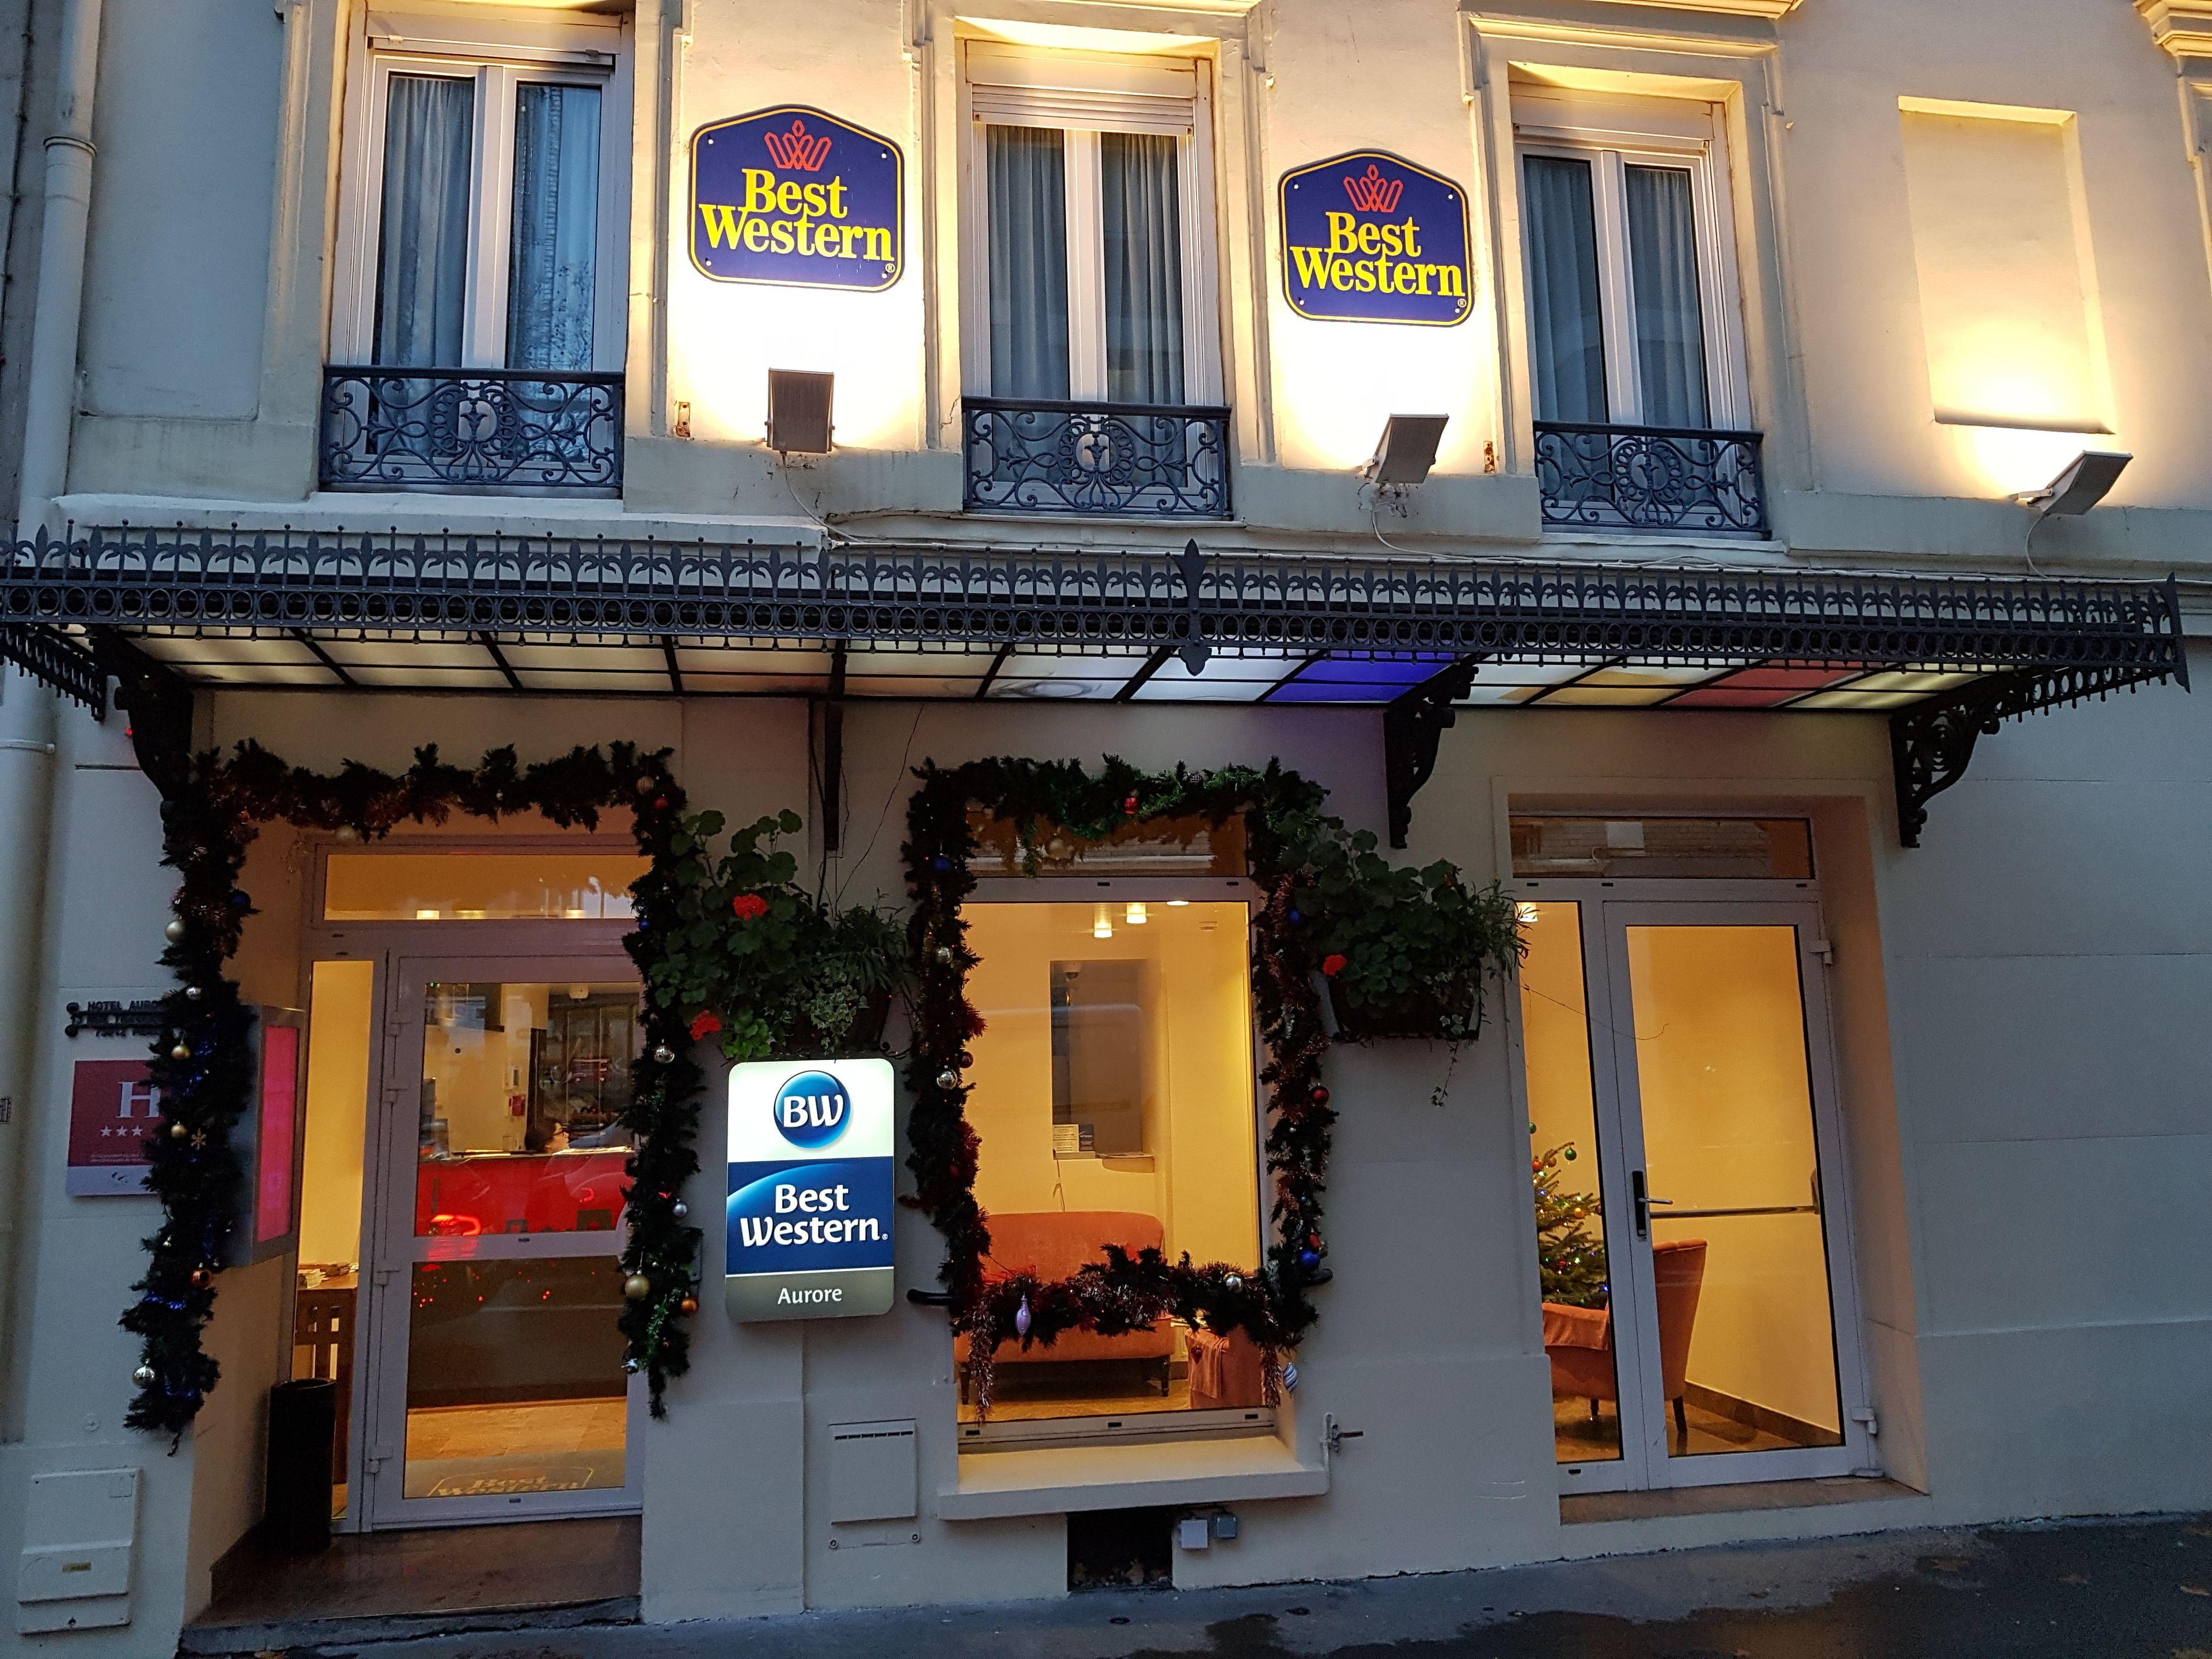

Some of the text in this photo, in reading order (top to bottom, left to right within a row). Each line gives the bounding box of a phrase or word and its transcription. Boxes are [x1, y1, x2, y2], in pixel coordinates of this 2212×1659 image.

[741, 168, 848, 218] Best
[698, 203, 895, 262] Western
[1325, 211, 1421, 257] Best
[1289, 244, 1465, 297] Western
[115, 1081, 164, 1118] H
[782, 1094, 844, 1128] BW
[775, 1184, 850, 1214] Best
[777, 1287, 843, 1305] Aurore
